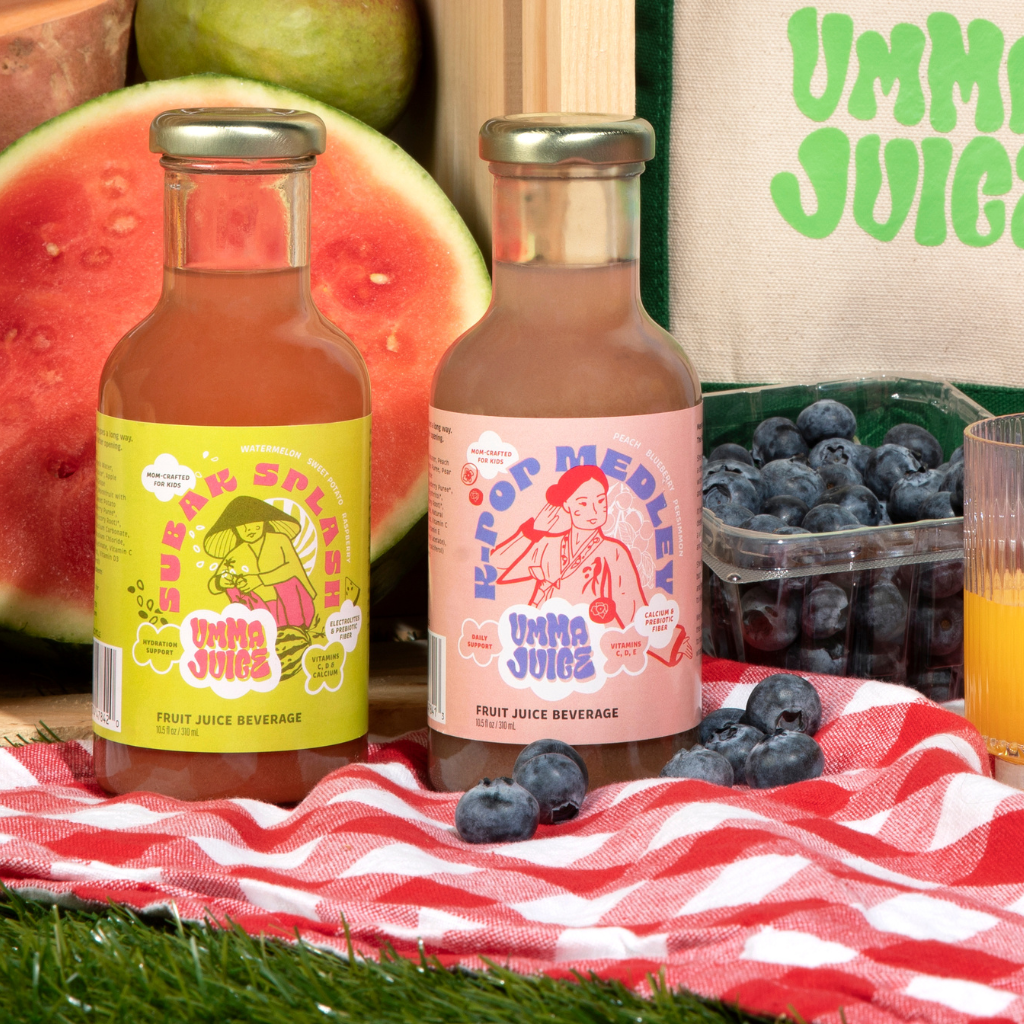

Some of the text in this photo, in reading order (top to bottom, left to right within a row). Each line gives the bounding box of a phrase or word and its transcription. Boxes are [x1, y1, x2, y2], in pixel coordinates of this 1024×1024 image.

[471, 449, 512, 457] MOM-CRAFTED
[146, 472, 190, 481] MOM-CRAFTED
[613, 432, 684, 557] PEACH BLUEBERRY PERSIMMON
[241, 444, 351, 563] WATERMELON SWEET POTATO RASPBERRY
[474, 457, 541, 601] K-POP
[555, 444, 674, 595] MEDLEY
[159, 463, 342, 614] SUBAK SPLASH
[645, 609, 669, 618] CALCIUM
[330, 615, 360, 627] ELECTROLYTES
[645, 616, 674, 626] PREBIOTIC
[190, 617, 266, 649] UMMA
[336, 624, 358, 633] PREBIOTIC
[509, 612, 589, 647] UMMA
[340, 632, 352, 641] FIBER
[472, 634, 488, 642] DAILY
[143, 639, 178, 648] HYDRATION
[468, 642, 493, 650] SUPPORT
[611, 641, 642, 650] VITAMINS
[146, 648, 174, 656] SUPPORT
[616, 650, 623, 658] C,
[312, 653, 340, 663] VITAMINS
[506, 645, 596, 681] JUICE
[188, 648, 270, 681] JUICE
[313, 670, 338, 678] CALCIUM
[476, 705, 619, 720] FRUIT JUICE BEVERAGE
[157, 712, 302, 726] FRUIT JUICE BEVERAGE
[476, 718, 484, 728] 10.5
[489, 721, 495, 729] oz
[499, 721, 508, 730] 310
[508, 722, 516, 730] mL
[156, 726, 166, 735] 10.5
[181, 728, 191, 736] 310
[191, 728, 199, 737] mL
